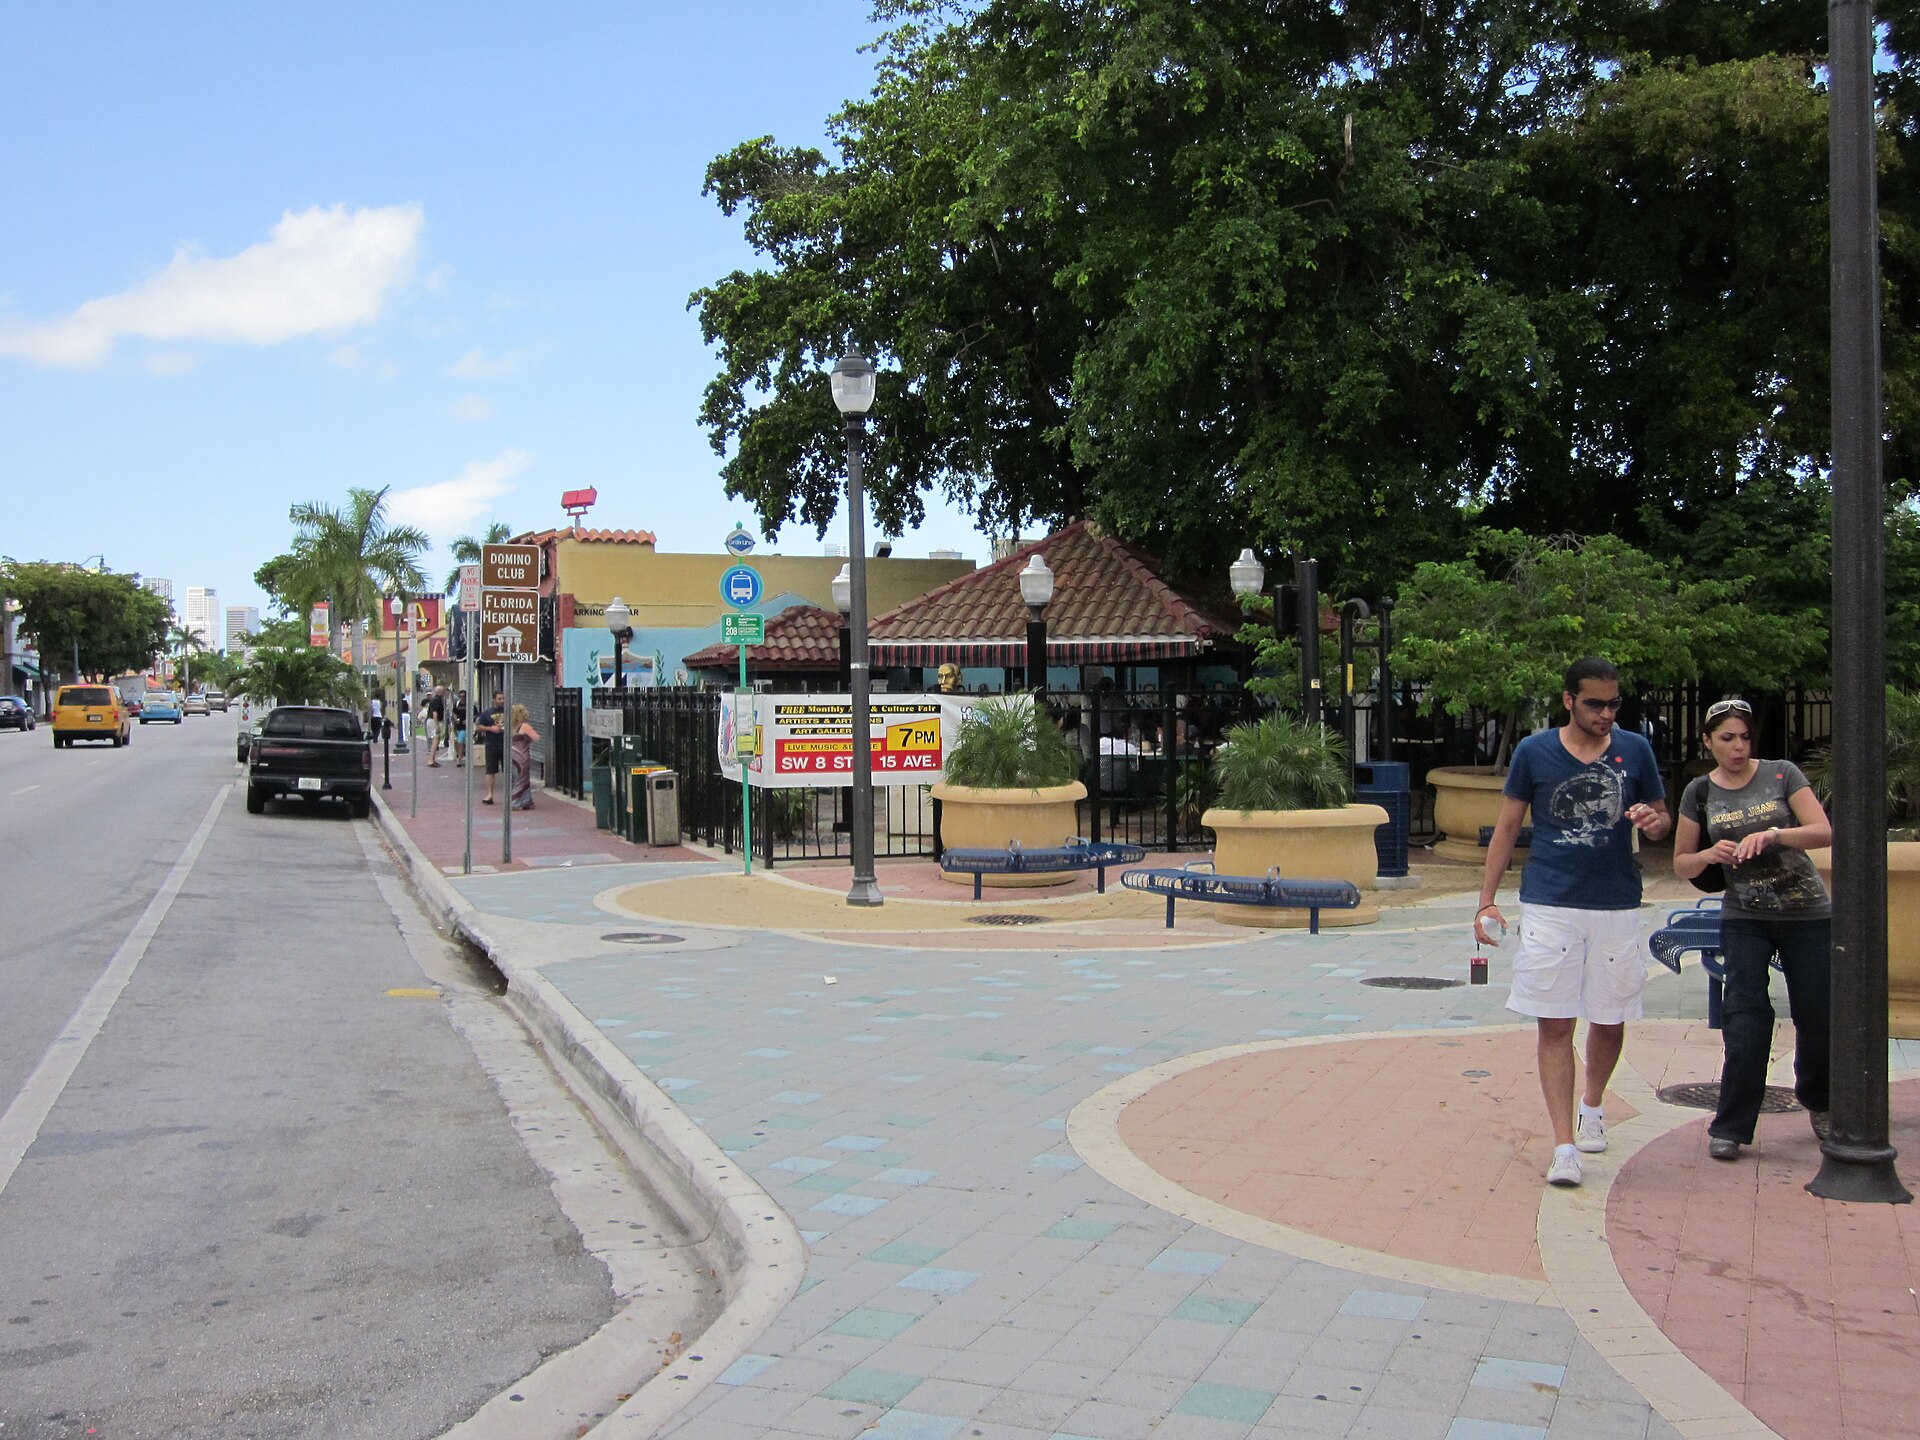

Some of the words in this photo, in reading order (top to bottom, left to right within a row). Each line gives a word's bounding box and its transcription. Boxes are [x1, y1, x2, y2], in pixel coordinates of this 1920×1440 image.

[490, 553, 531, 565] DOMINO
[497, 568, 525, 579] CLUB
[485, 595, 533, 609] FLORIDA
[483, 610, 535, 625] HERITAGE
[573, 608, 604, 616] ARKING
[725, 617, 732, 626] 8
[780, 706, 805, 714] FREE
[808, 705, 845, 714] Monthly
[787, 743, 807, 751] LIVE
[810, 743, 838, 751] MUSIC
[781, 757, 808, 770] SW
[815, 757, 826, 769] 8
[879, 756, 896, 768] 15
[903, 755, 936, 768] AVE.
